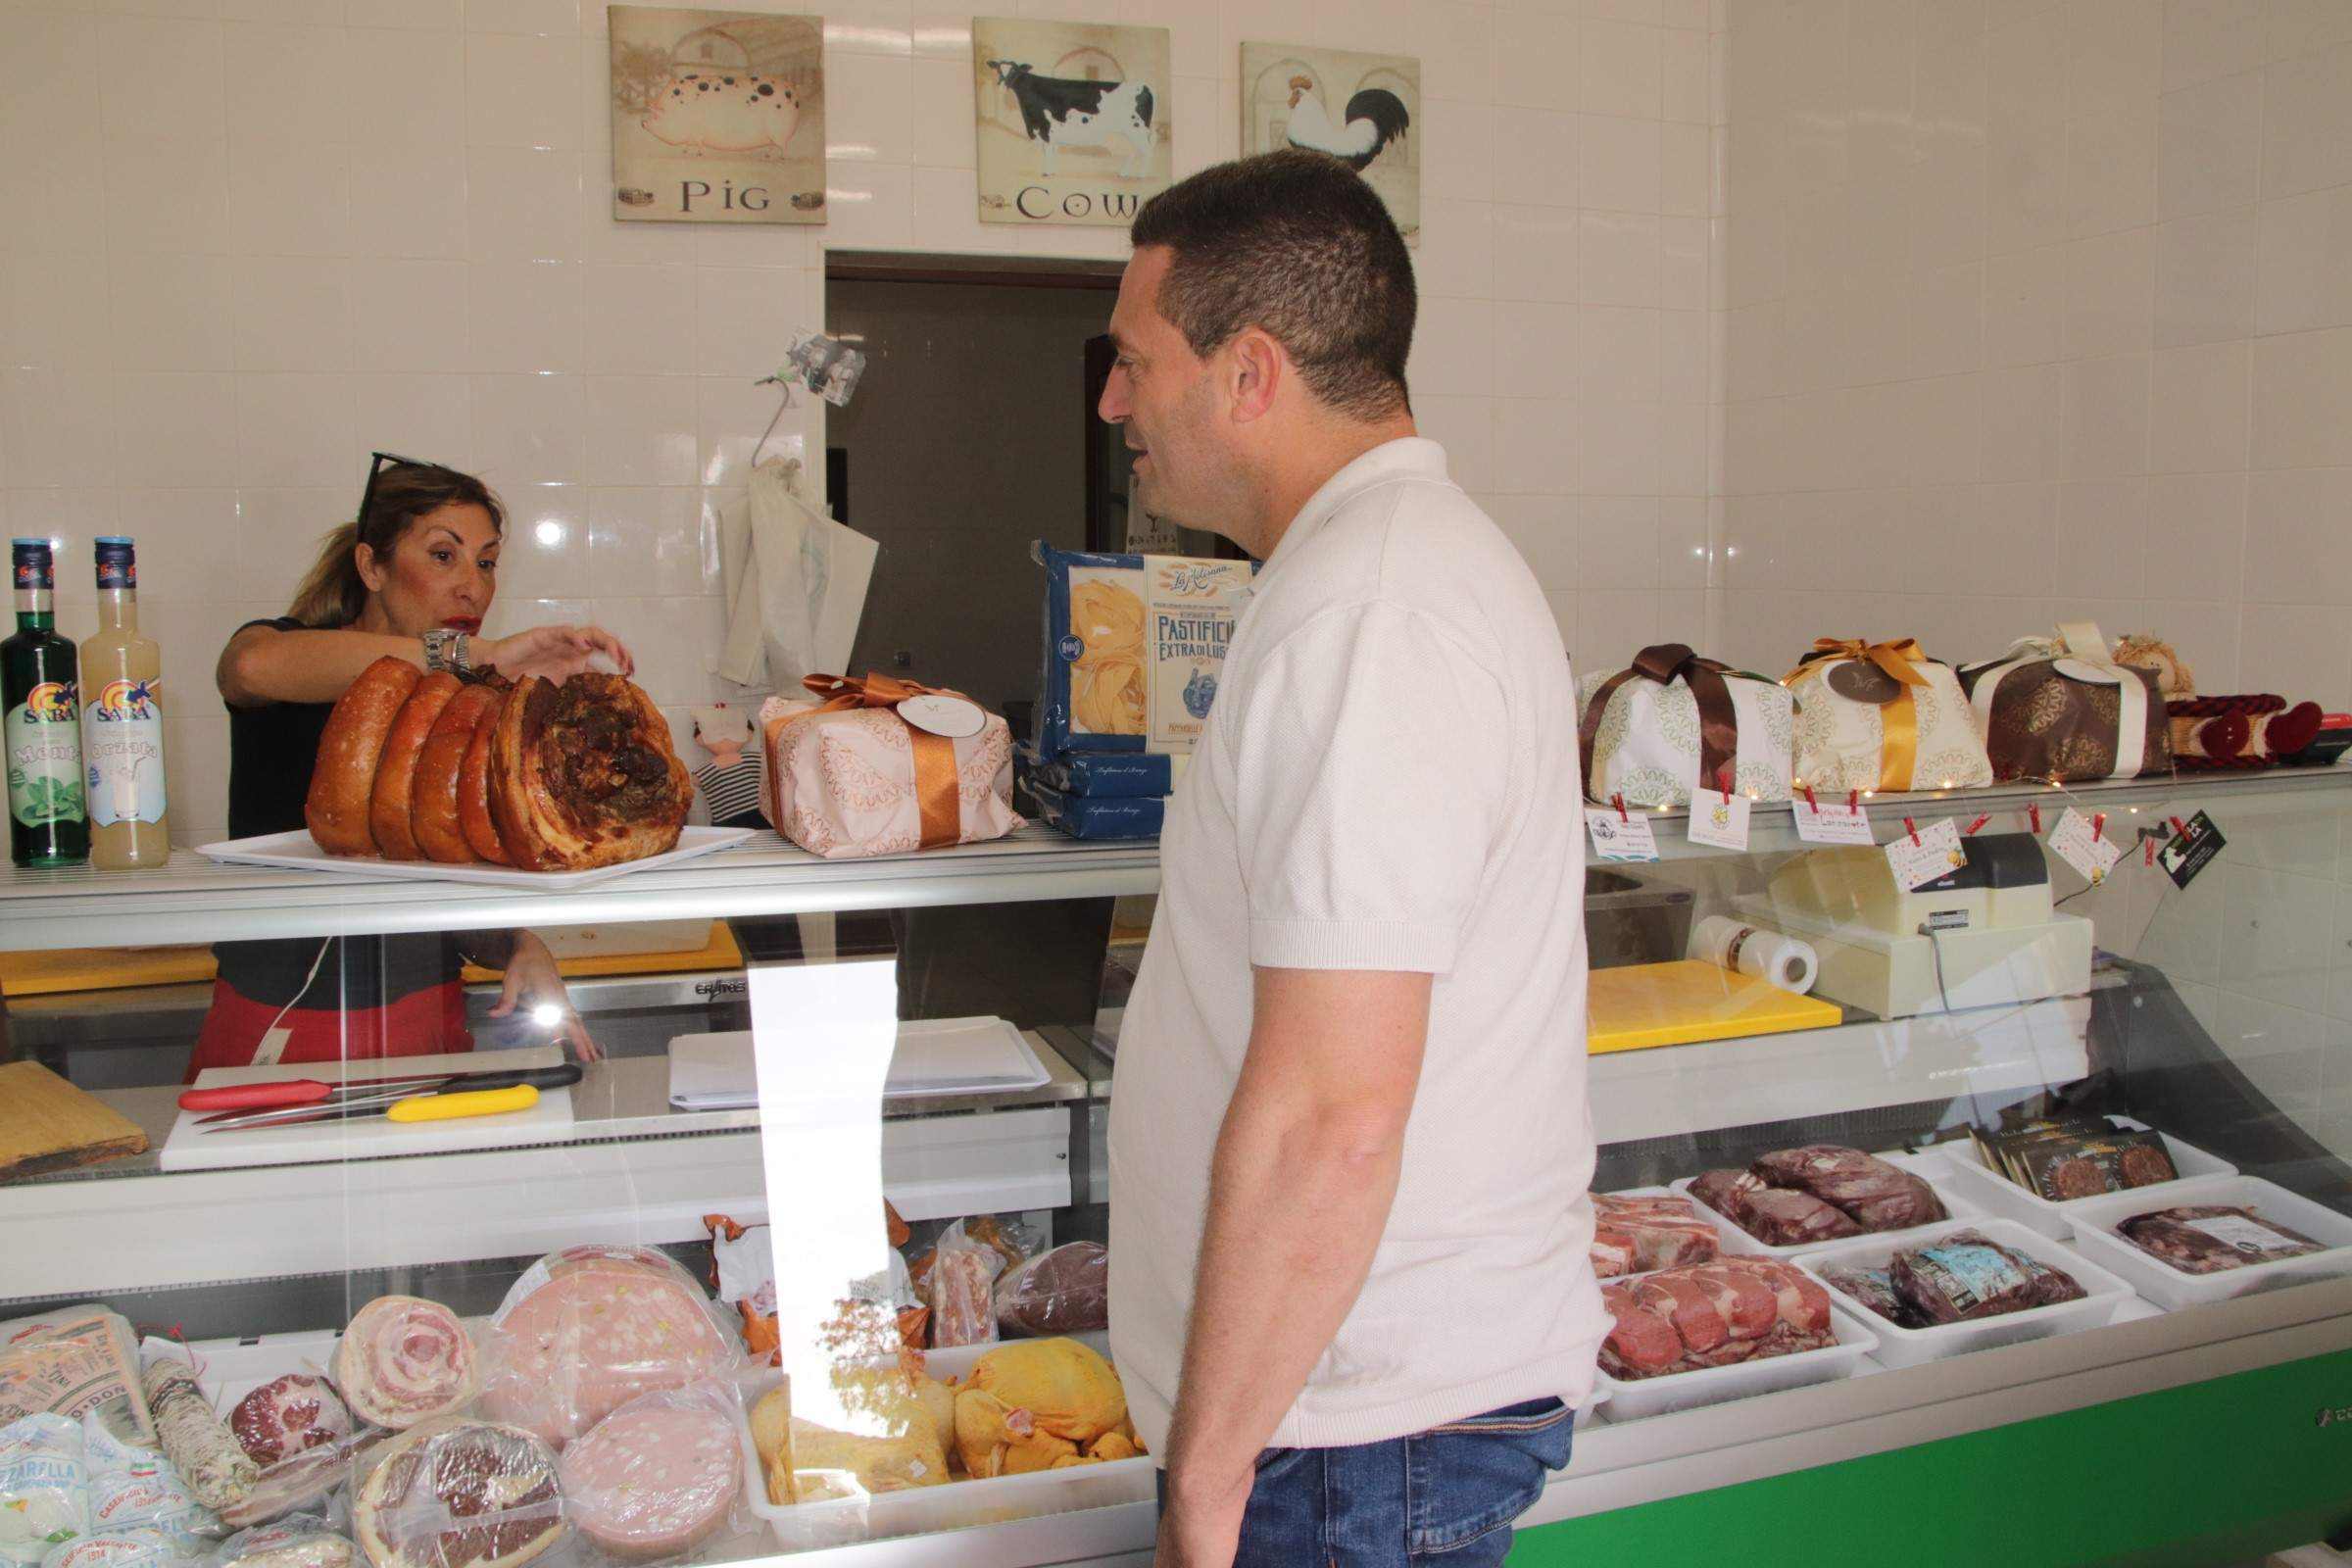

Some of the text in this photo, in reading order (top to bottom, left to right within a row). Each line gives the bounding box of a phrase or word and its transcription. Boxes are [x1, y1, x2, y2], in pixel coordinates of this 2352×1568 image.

[1158, 615, 1235, 643] PASTIFICI
[1159, 642, 1196, 662] EXTRA
[1206, 643, 1229, 660] LUS
[24, 708, 75, 723] SABA
